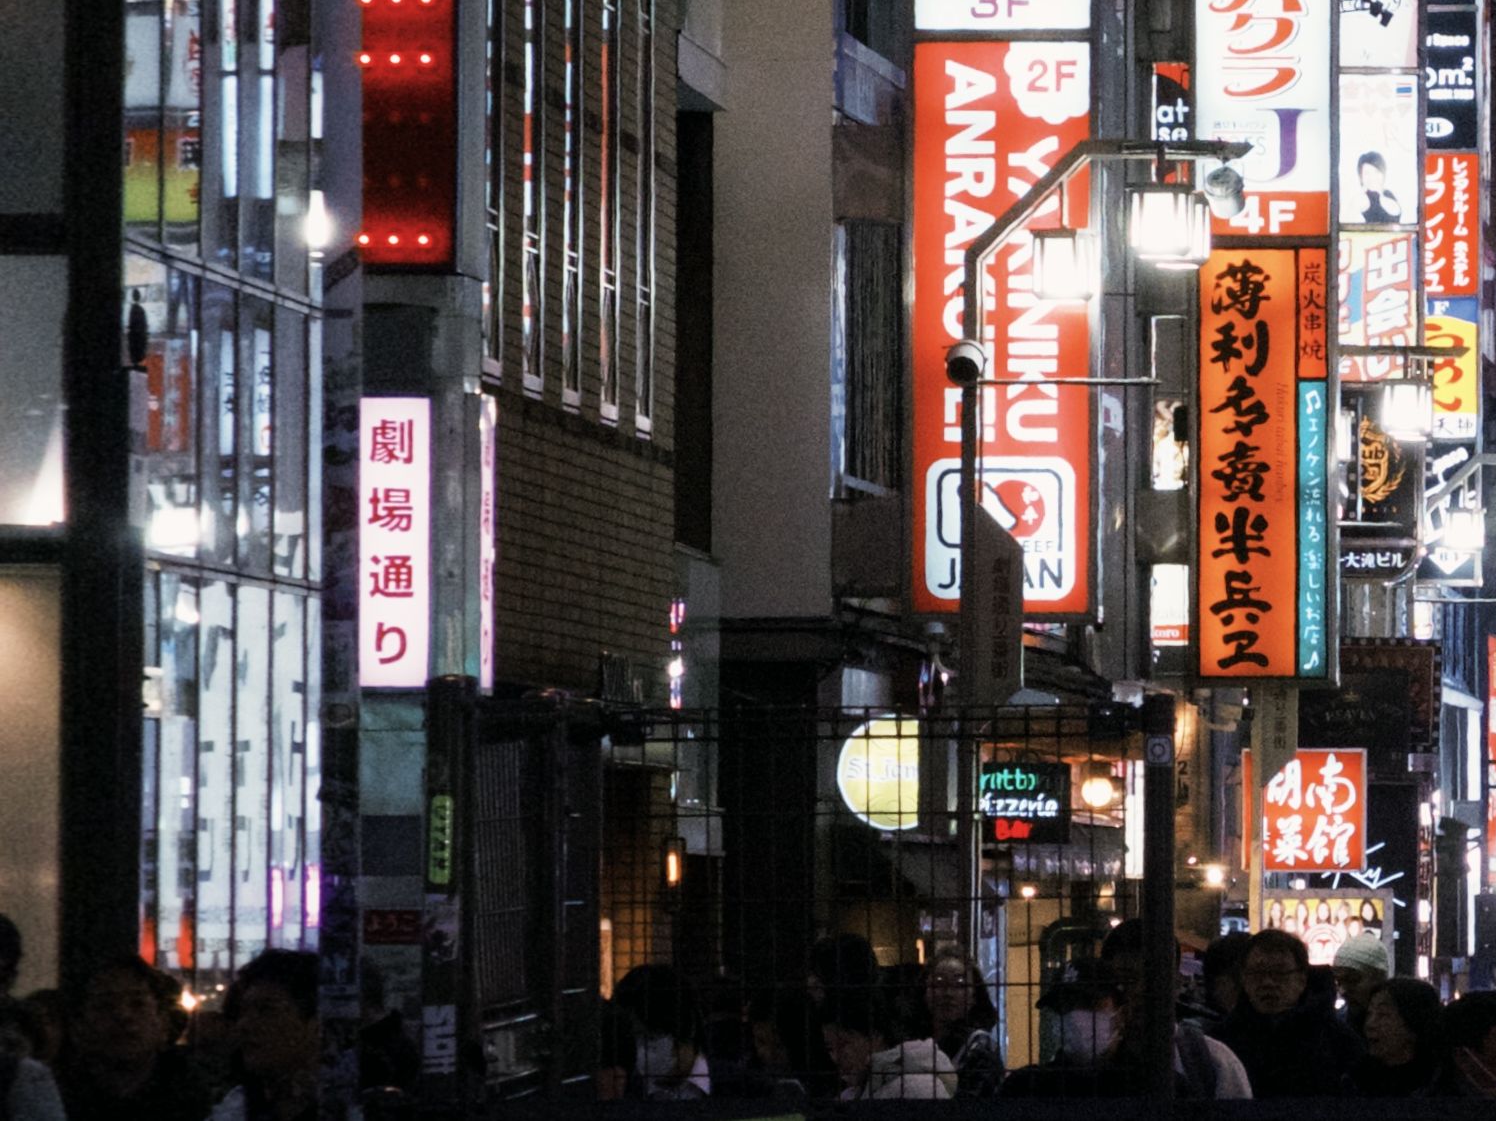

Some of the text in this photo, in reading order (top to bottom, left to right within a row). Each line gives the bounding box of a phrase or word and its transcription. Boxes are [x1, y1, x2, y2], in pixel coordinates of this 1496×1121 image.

[1027, 59, 1077, 92] 2F
[1228, 196, 1297, 234] 4F
[943, 60, 996, 442] ANRAKUEI
[1299, 262, 1327, 362] 炭火串焼
[368, 419, 414, 665] 劇場通り
[938, 558, 1063, 590] JAN
